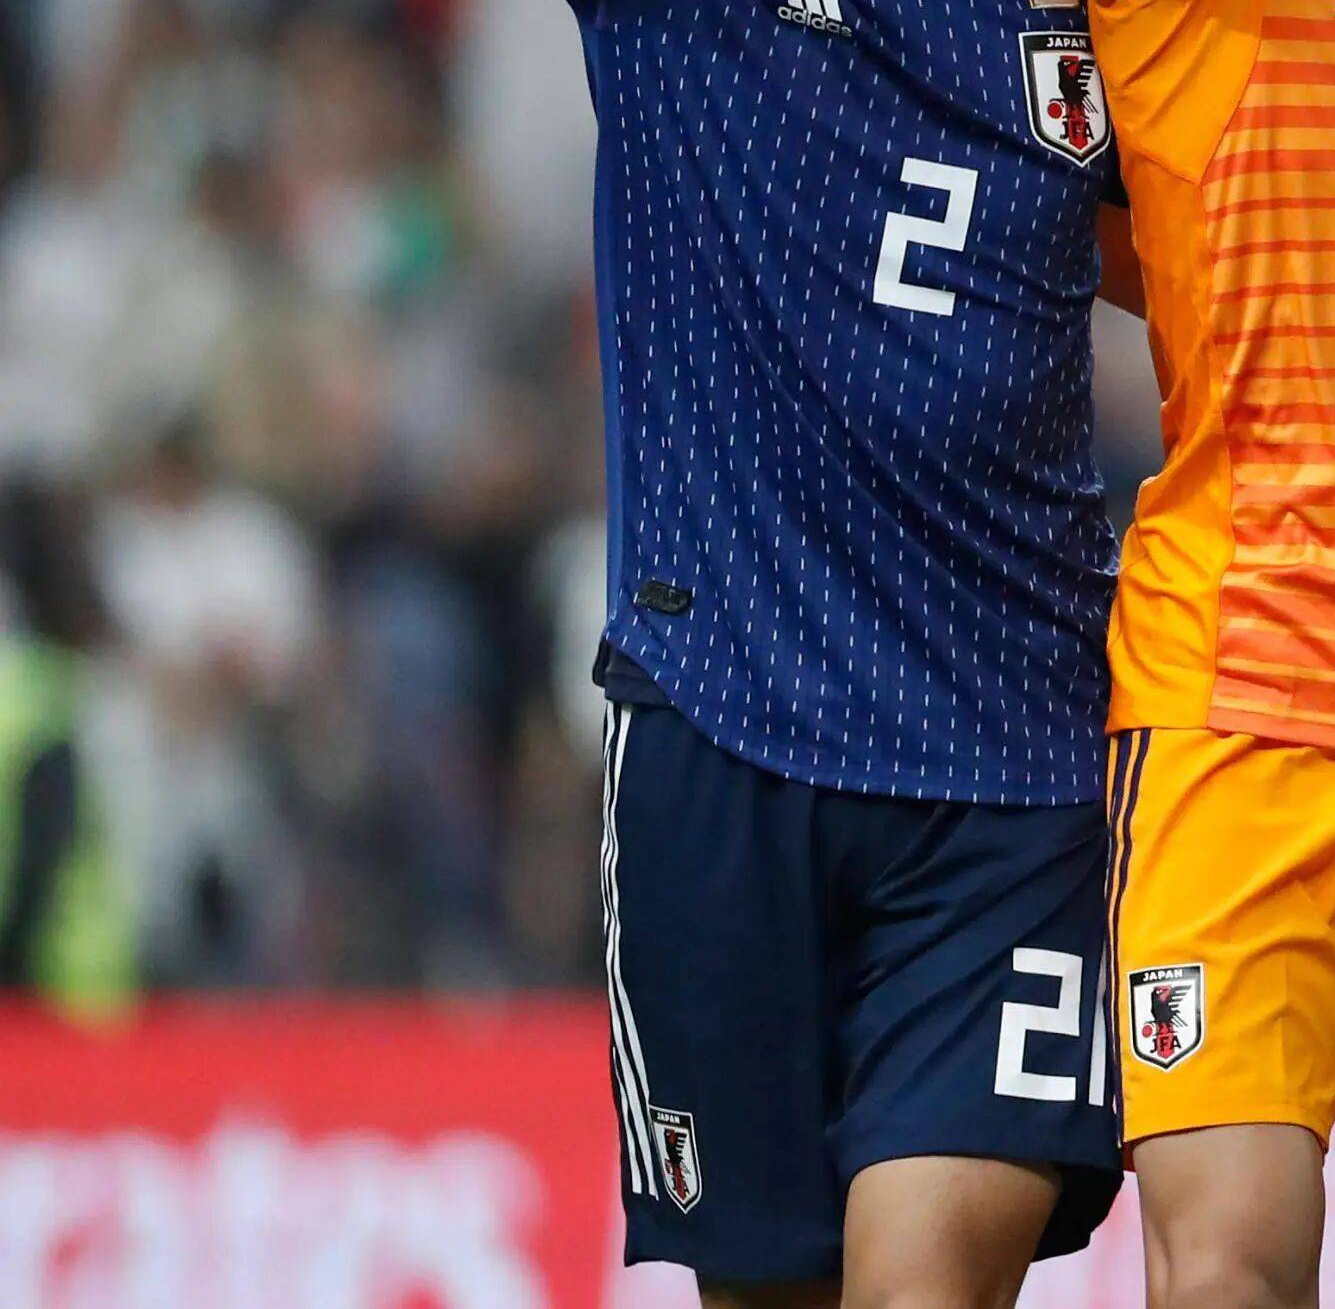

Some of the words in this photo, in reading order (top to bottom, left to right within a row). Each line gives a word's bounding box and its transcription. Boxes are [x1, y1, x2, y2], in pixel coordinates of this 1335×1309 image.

[778, 4, 852, 38] adidas
[1046, 36, 1087, 49] JAPAN
[873, 157, 978, 316] 2
[1143, 969, 1183, 982] JAPAN
[1150, 1036, 1181, 1053] JFA
[657, 1112, 680, 1124] JAPAN
